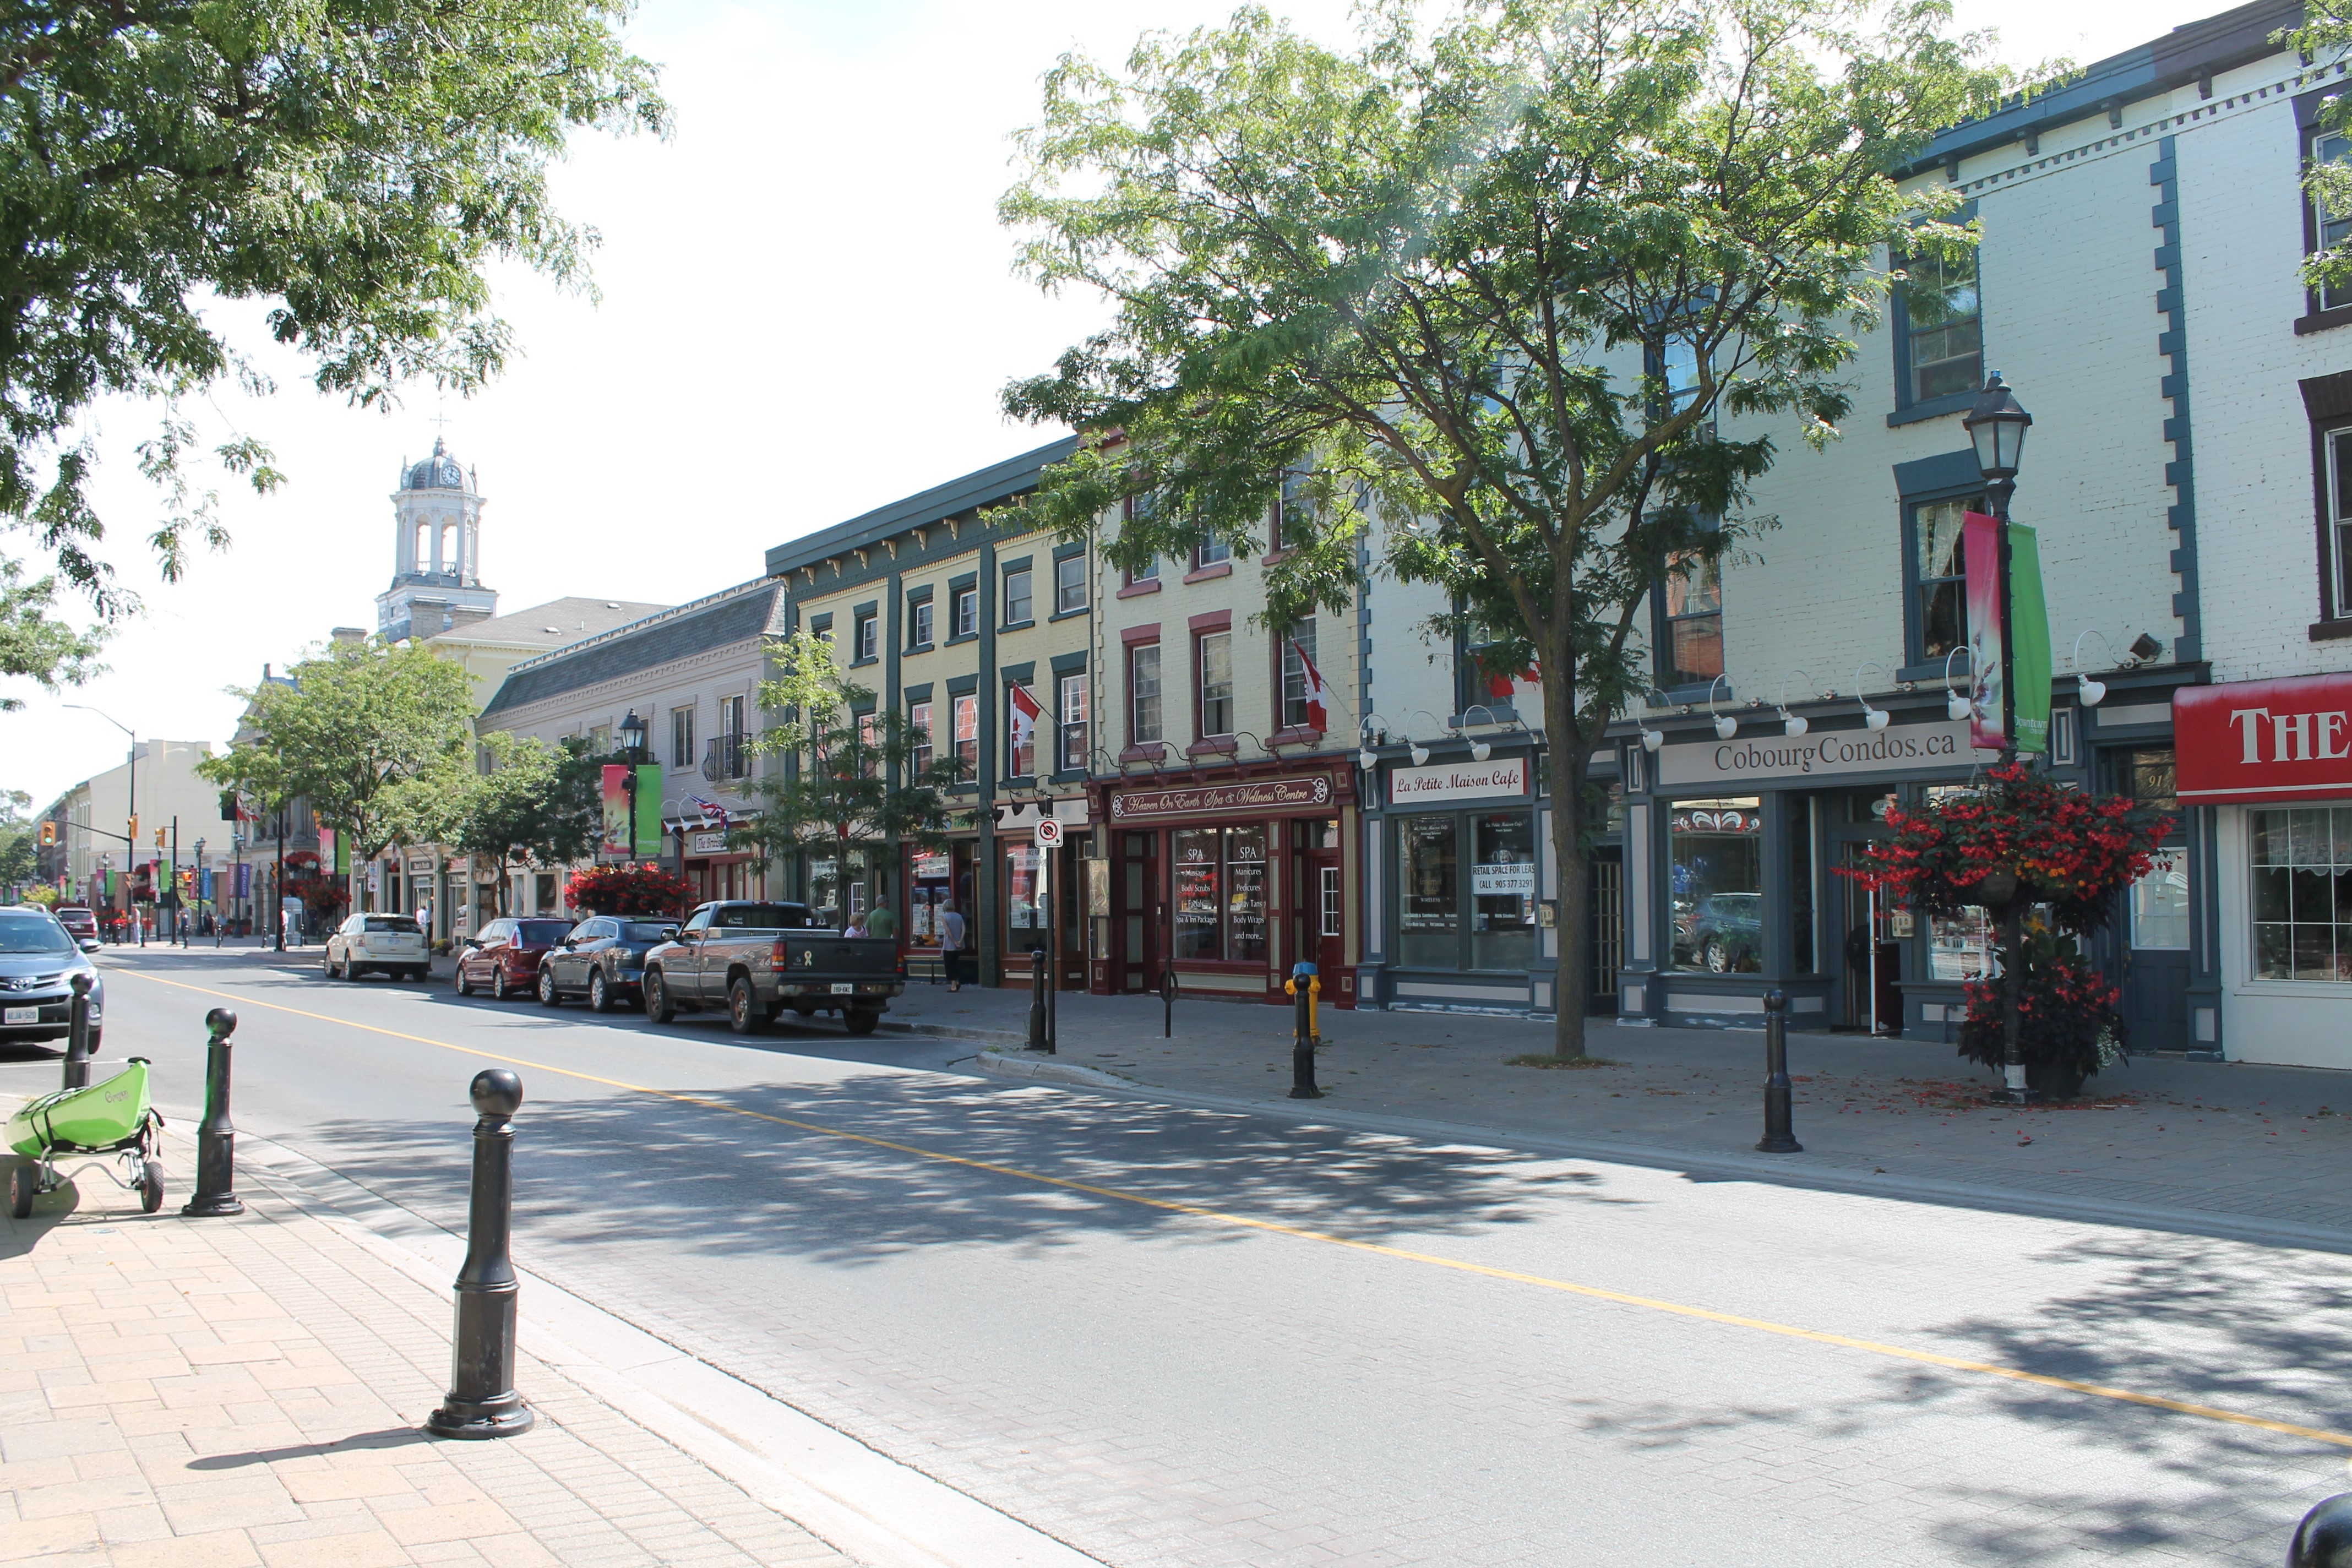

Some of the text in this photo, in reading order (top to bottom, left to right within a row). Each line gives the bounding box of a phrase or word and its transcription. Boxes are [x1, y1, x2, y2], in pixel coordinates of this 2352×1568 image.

[2015, 715, 2048, 728] Downtown
[2229, 707, 2351, 764] THE
[1714, 733, 1957, 772] CobourgCondos.ca
[1396, 769, 1519, 793] La Petite Maison Cafe
[2149, 775, 2163, 787] 91
[1128, 784, 1308, 812] Heaven On Earth Spa & Wellness Centre
[698, 835, 725, 850] The Britis
[1188, 849, 1204, 861] SPA
[1240, 847, 1257, 859] SPA
[1185, 870, 1206, 878] Massage
[1473, 865, 1535, 875] RETAIL SPACE FOR LEAS
[1182, 884, 1211, 893] Body Scrubs
[1479, 880, 1491, 889] CALL
[1518, 879, 1533, 888] 3291
[1250, 899, 1263, 907] Tans
[1197, 916, 1217, 925] Packages
[1233, 916, 1265, 925] Body Wraps
